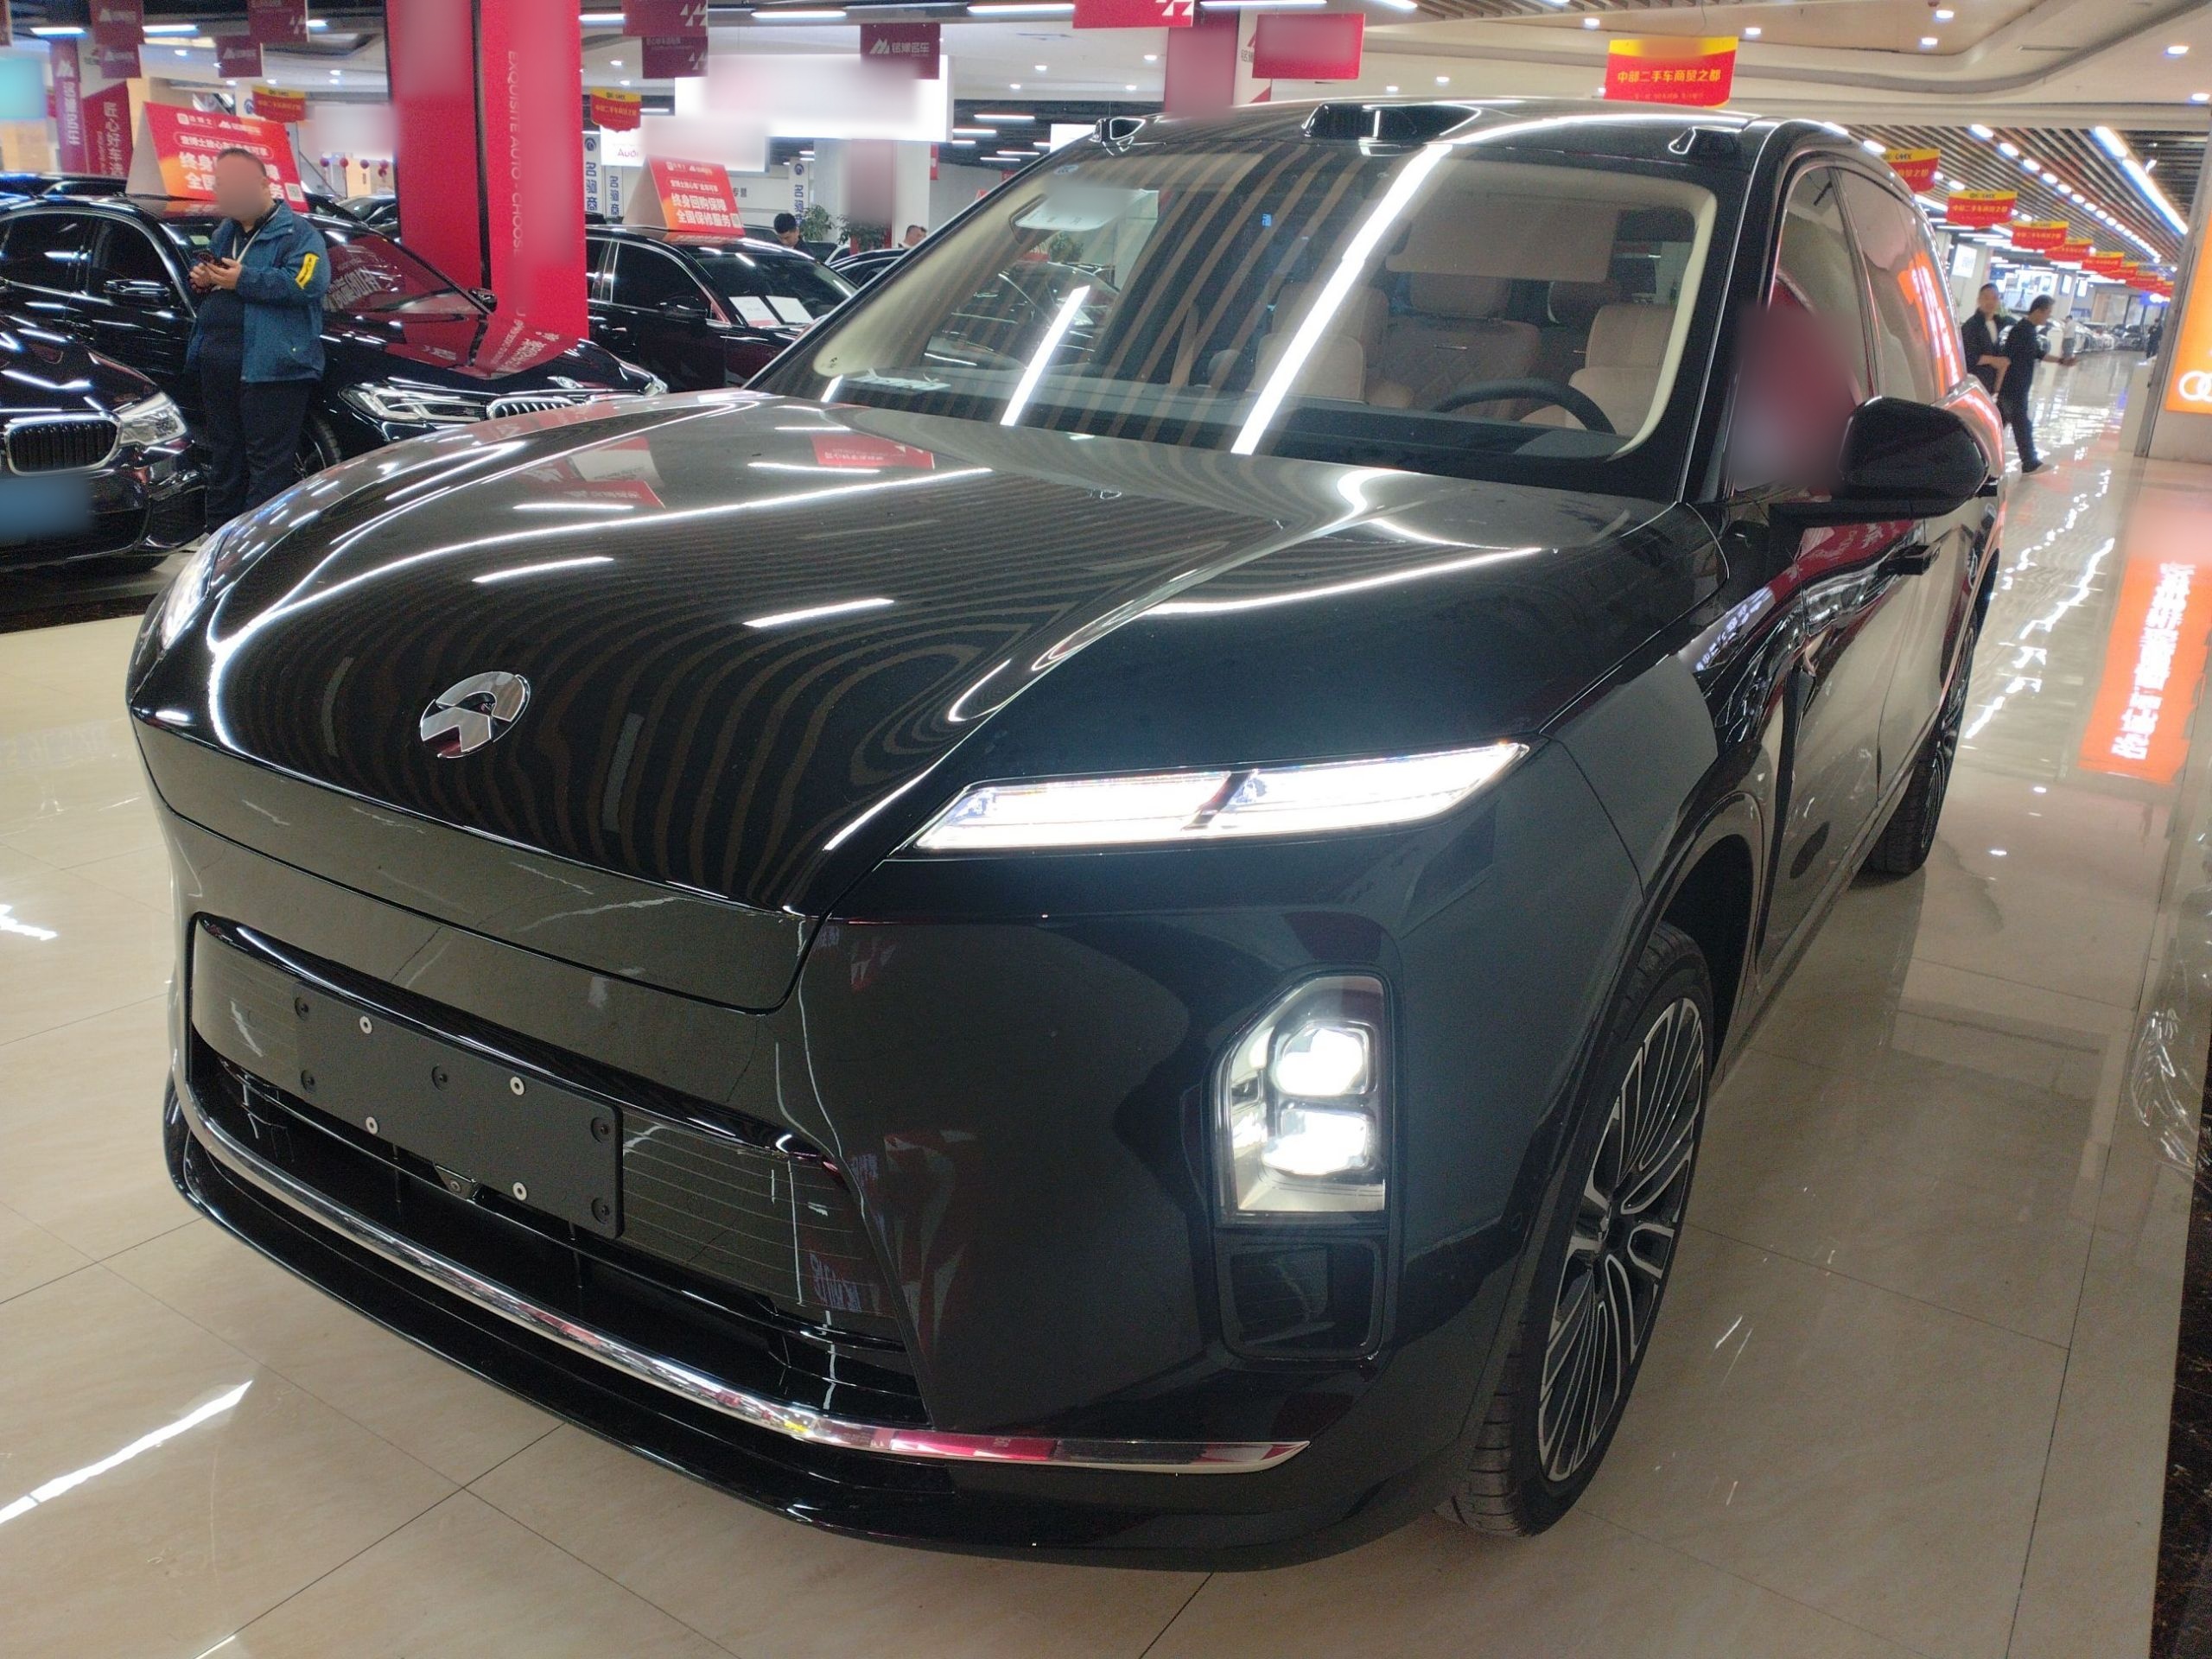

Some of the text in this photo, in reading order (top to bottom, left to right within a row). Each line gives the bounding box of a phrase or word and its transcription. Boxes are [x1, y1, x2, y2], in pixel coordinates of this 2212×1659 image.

[507, 50, 520, 132] EXQUISITE
[1618, 69, 1721, 84] 中部二手车商贸之都
[510, 135, 522, 180] AUTO
[512, 191, 524, 257] CHOOSE
